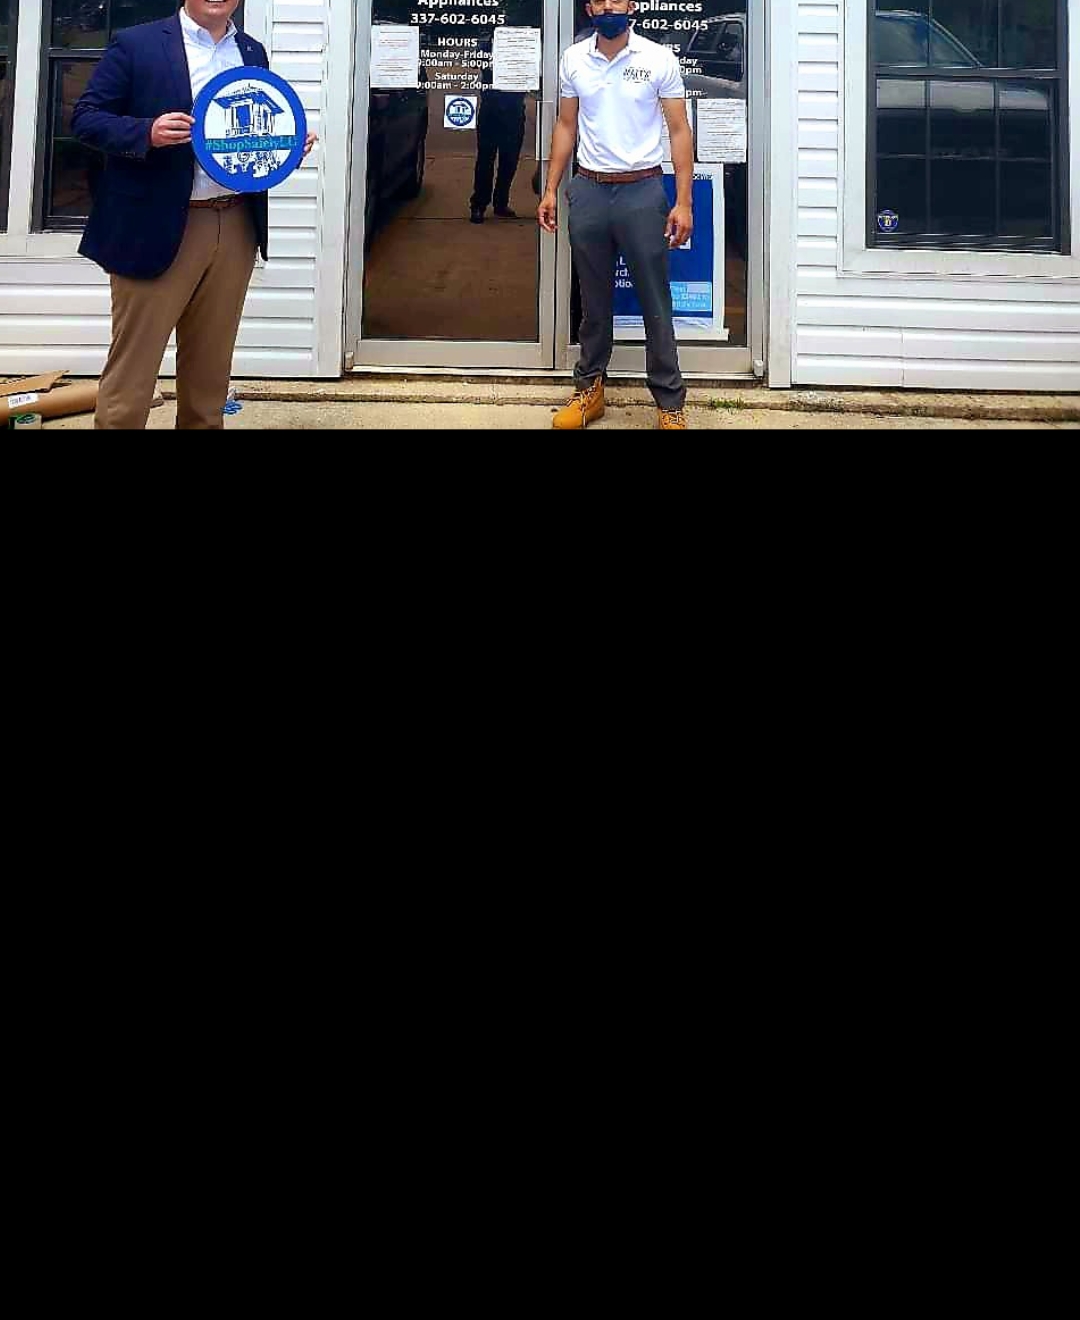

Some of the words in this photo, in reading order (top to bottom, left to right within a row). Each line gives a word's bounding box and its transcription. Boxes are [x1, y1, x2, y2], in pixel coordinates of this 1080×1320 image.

[410, 13, 505, 25] 337-602-6045
[628, 18, 709, 31] 7-602-6045
[437, 37, 478, 47] HOURS
[434, 72, 479, 82] Saturday
